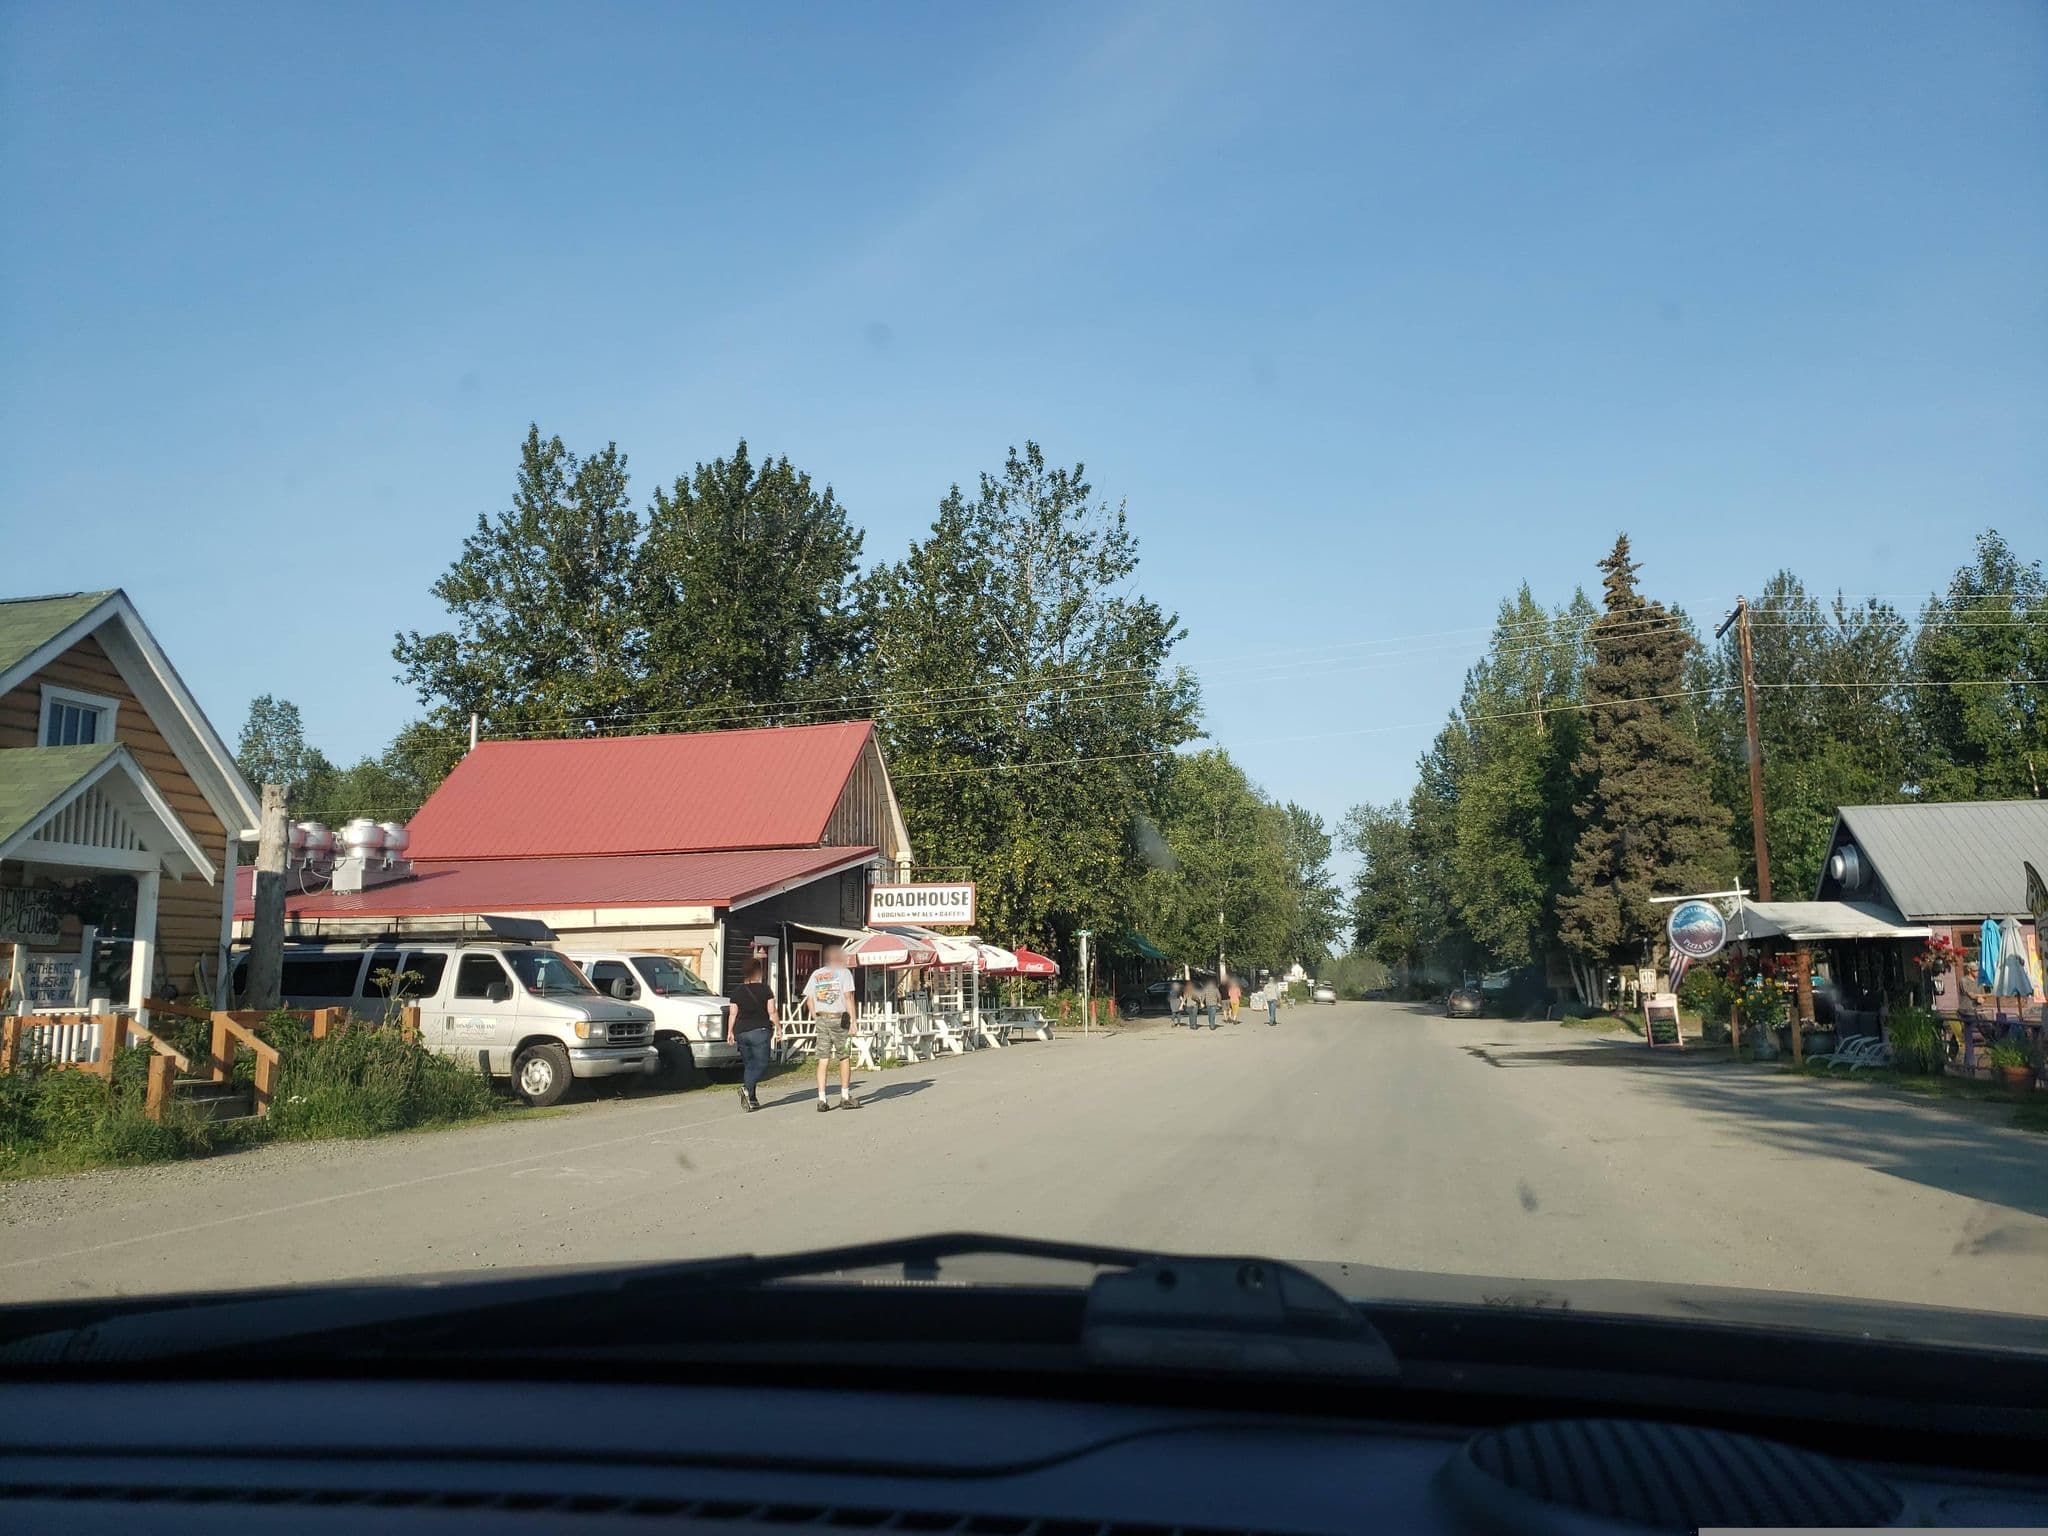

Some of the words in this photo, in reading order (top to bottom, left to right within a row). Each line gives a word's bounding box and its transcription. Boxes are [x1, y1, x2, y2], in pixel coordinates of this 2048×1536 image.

[873, 891, 969, 907] ROADHOUSE
[26, 962, 73, 975] AUTHENTIC
[30, 976, 69, 987] ALASKAN
